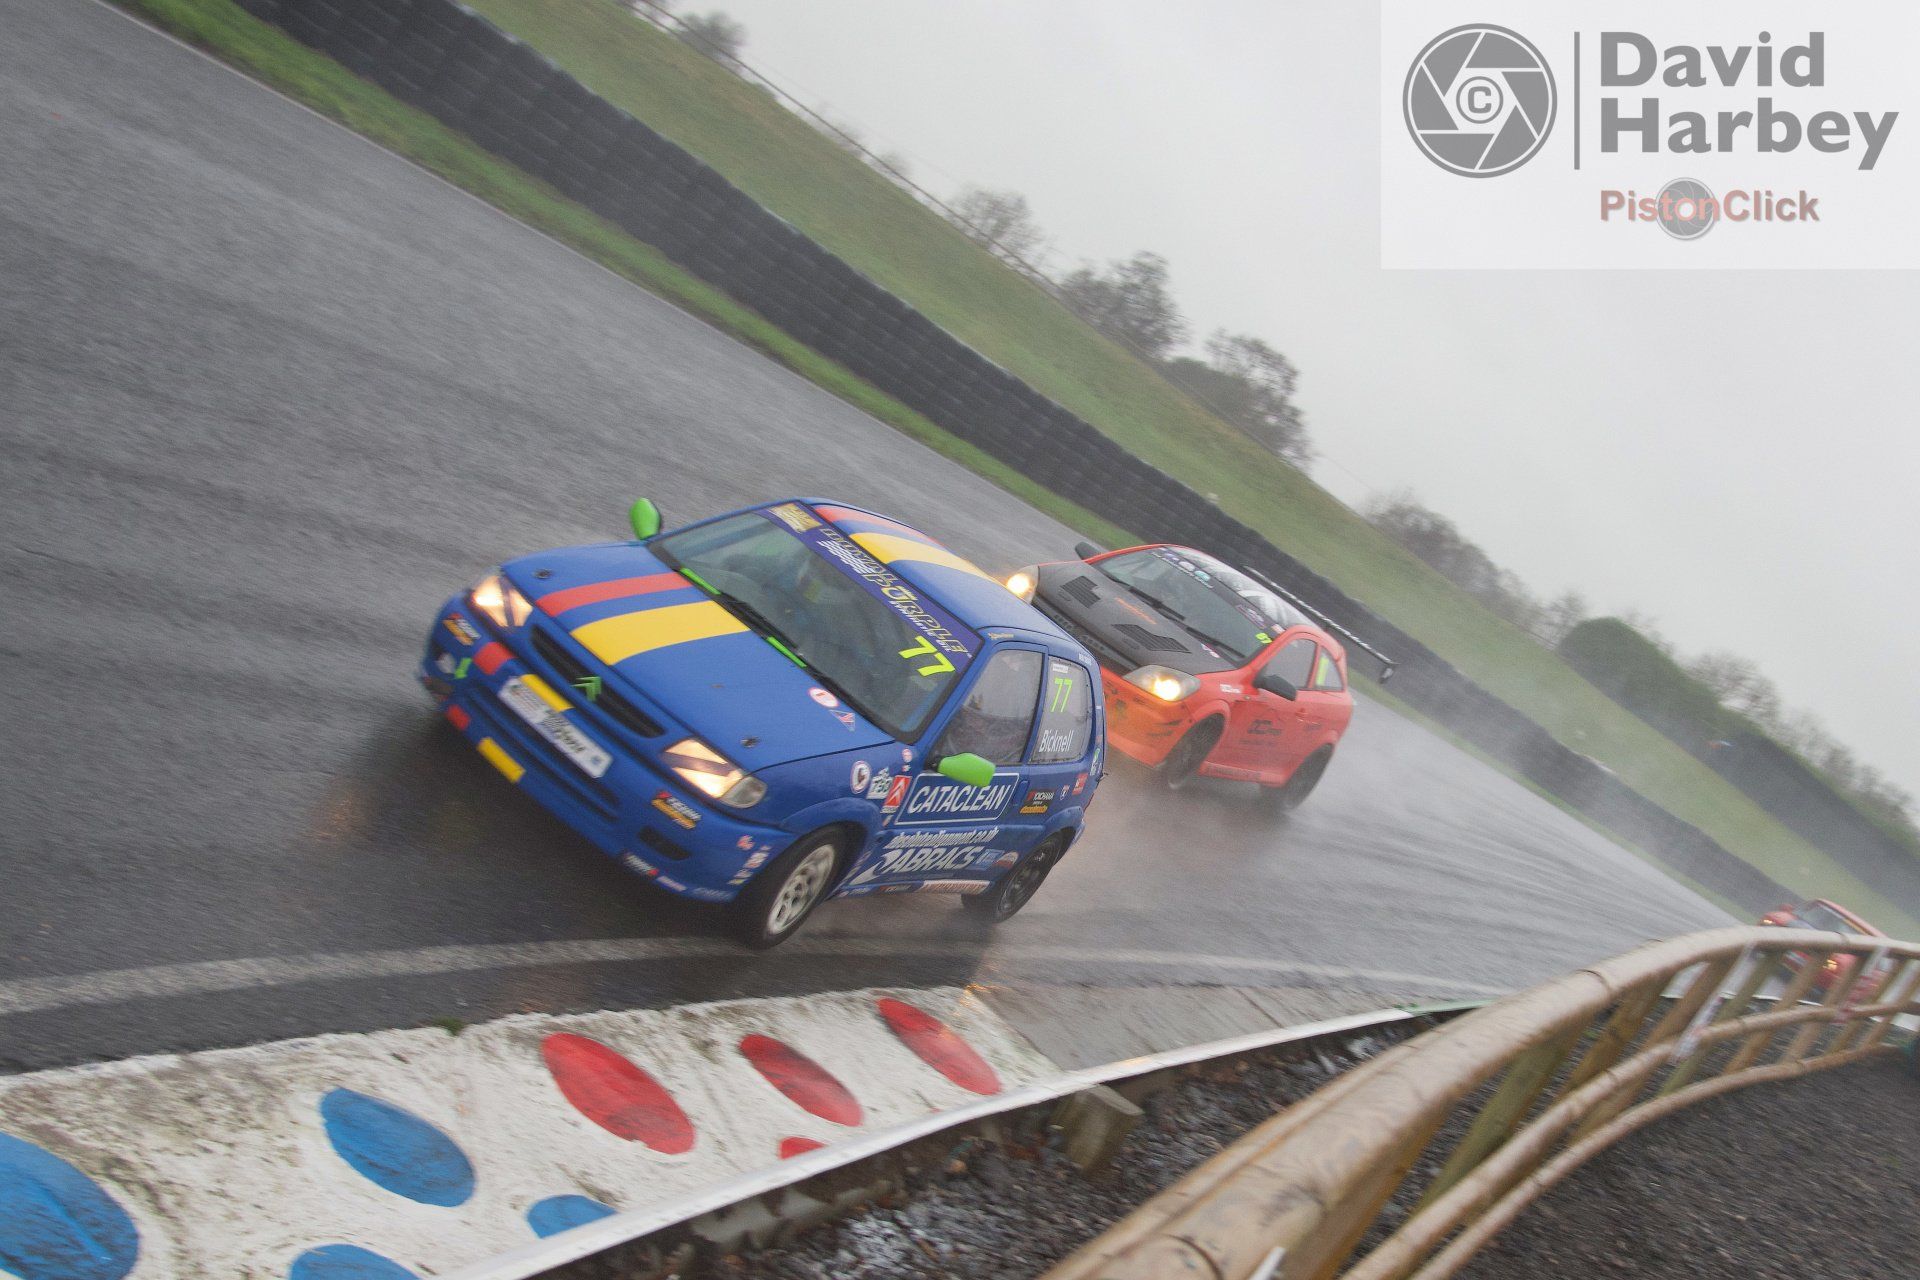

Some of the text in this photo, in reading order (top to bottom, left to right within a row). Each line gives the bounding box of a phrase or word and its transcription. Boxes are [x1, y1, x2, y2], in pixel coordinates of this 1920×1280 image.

[861, 573, 969, 653] PURPLE
[898, 635, 956, 677] 77
[1050, 677, 1073, 713] 77
[1038, 729, 1075, 753] Bicknell
[906, 783, 1010, 815] CATACLEAN
[880, 845, 985, 874] ABRACS
